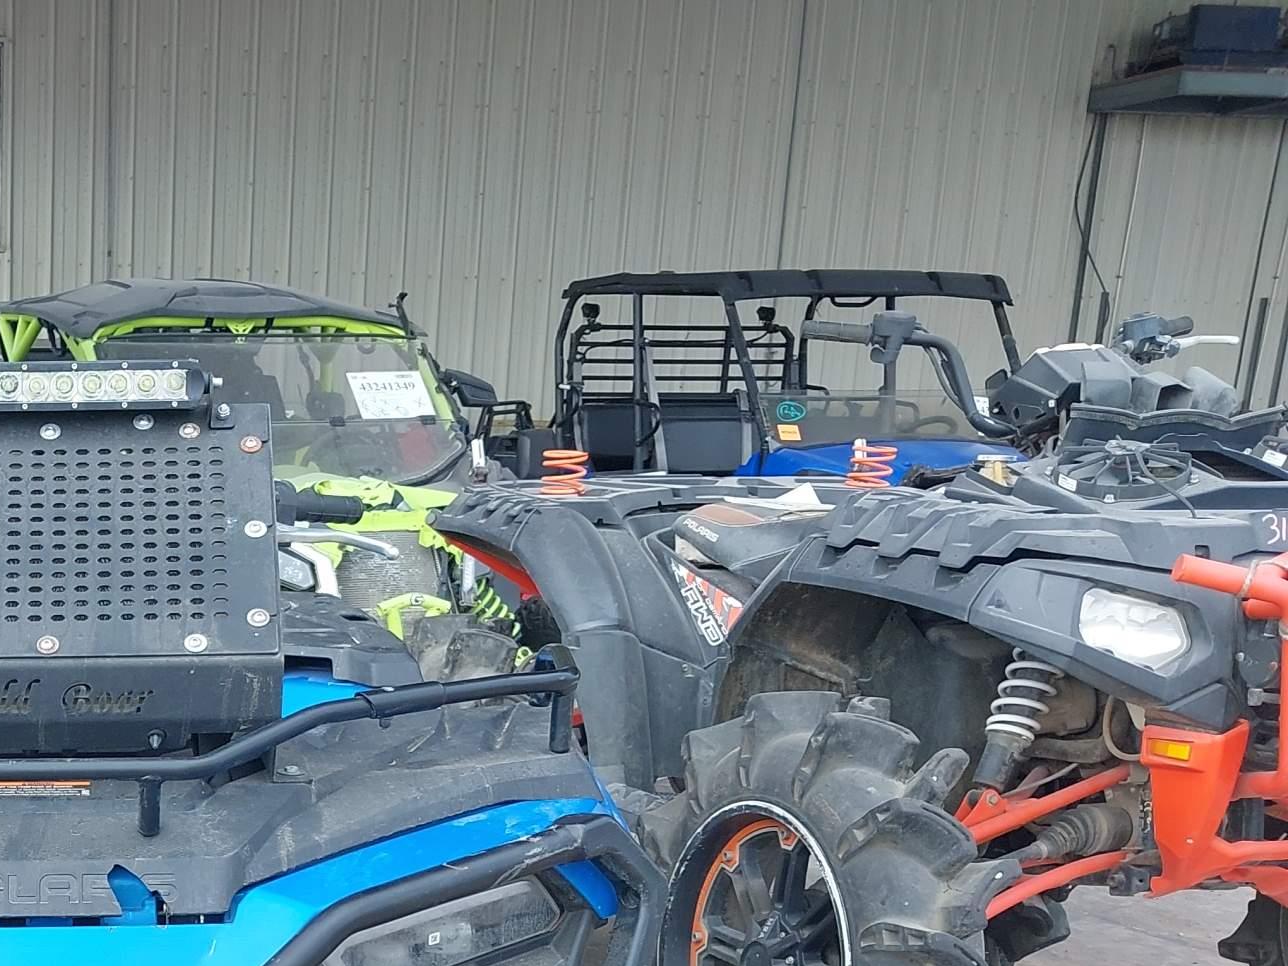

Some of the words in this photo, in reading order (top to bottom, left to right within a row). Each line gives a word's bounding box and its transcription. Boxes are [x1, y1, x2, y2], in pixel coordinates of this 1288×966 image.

[359, 382, 416, 392] 43241349
[682, 518, 720, 543] POLARIS
[62, 681, 155, 716] Boar
